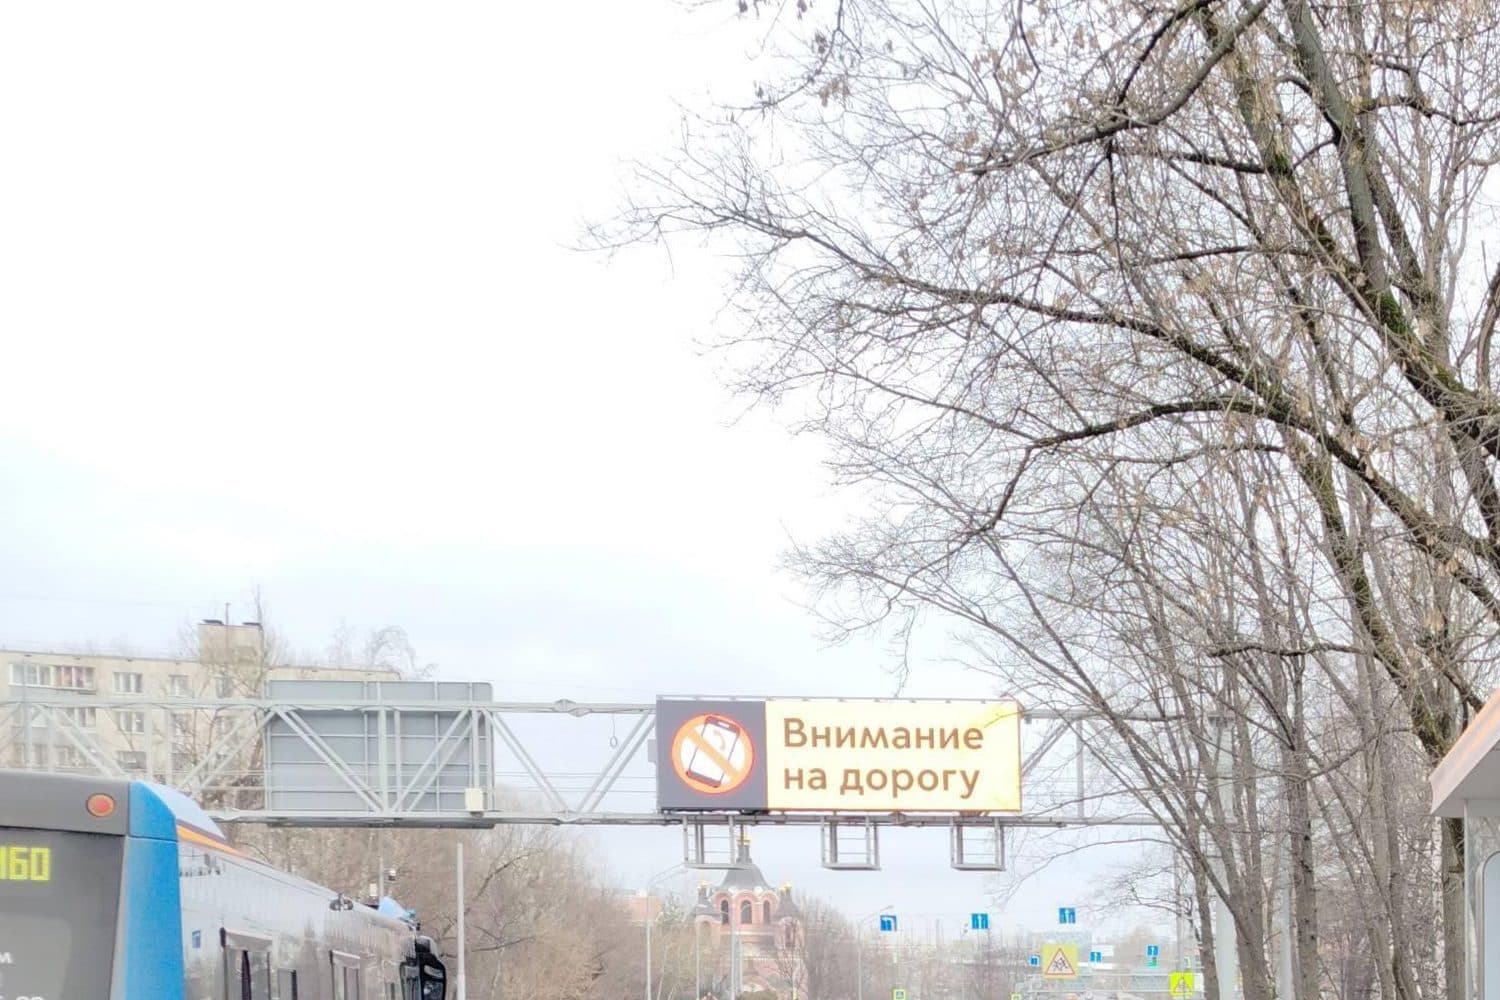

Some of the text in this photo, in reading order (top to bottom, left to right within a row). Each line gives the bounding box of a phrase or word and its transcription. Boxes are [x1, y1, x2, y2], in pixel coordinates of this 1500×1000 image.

[783, 717, 984, 750] Внимание
[784, 767, 980, 799] на дорогу
